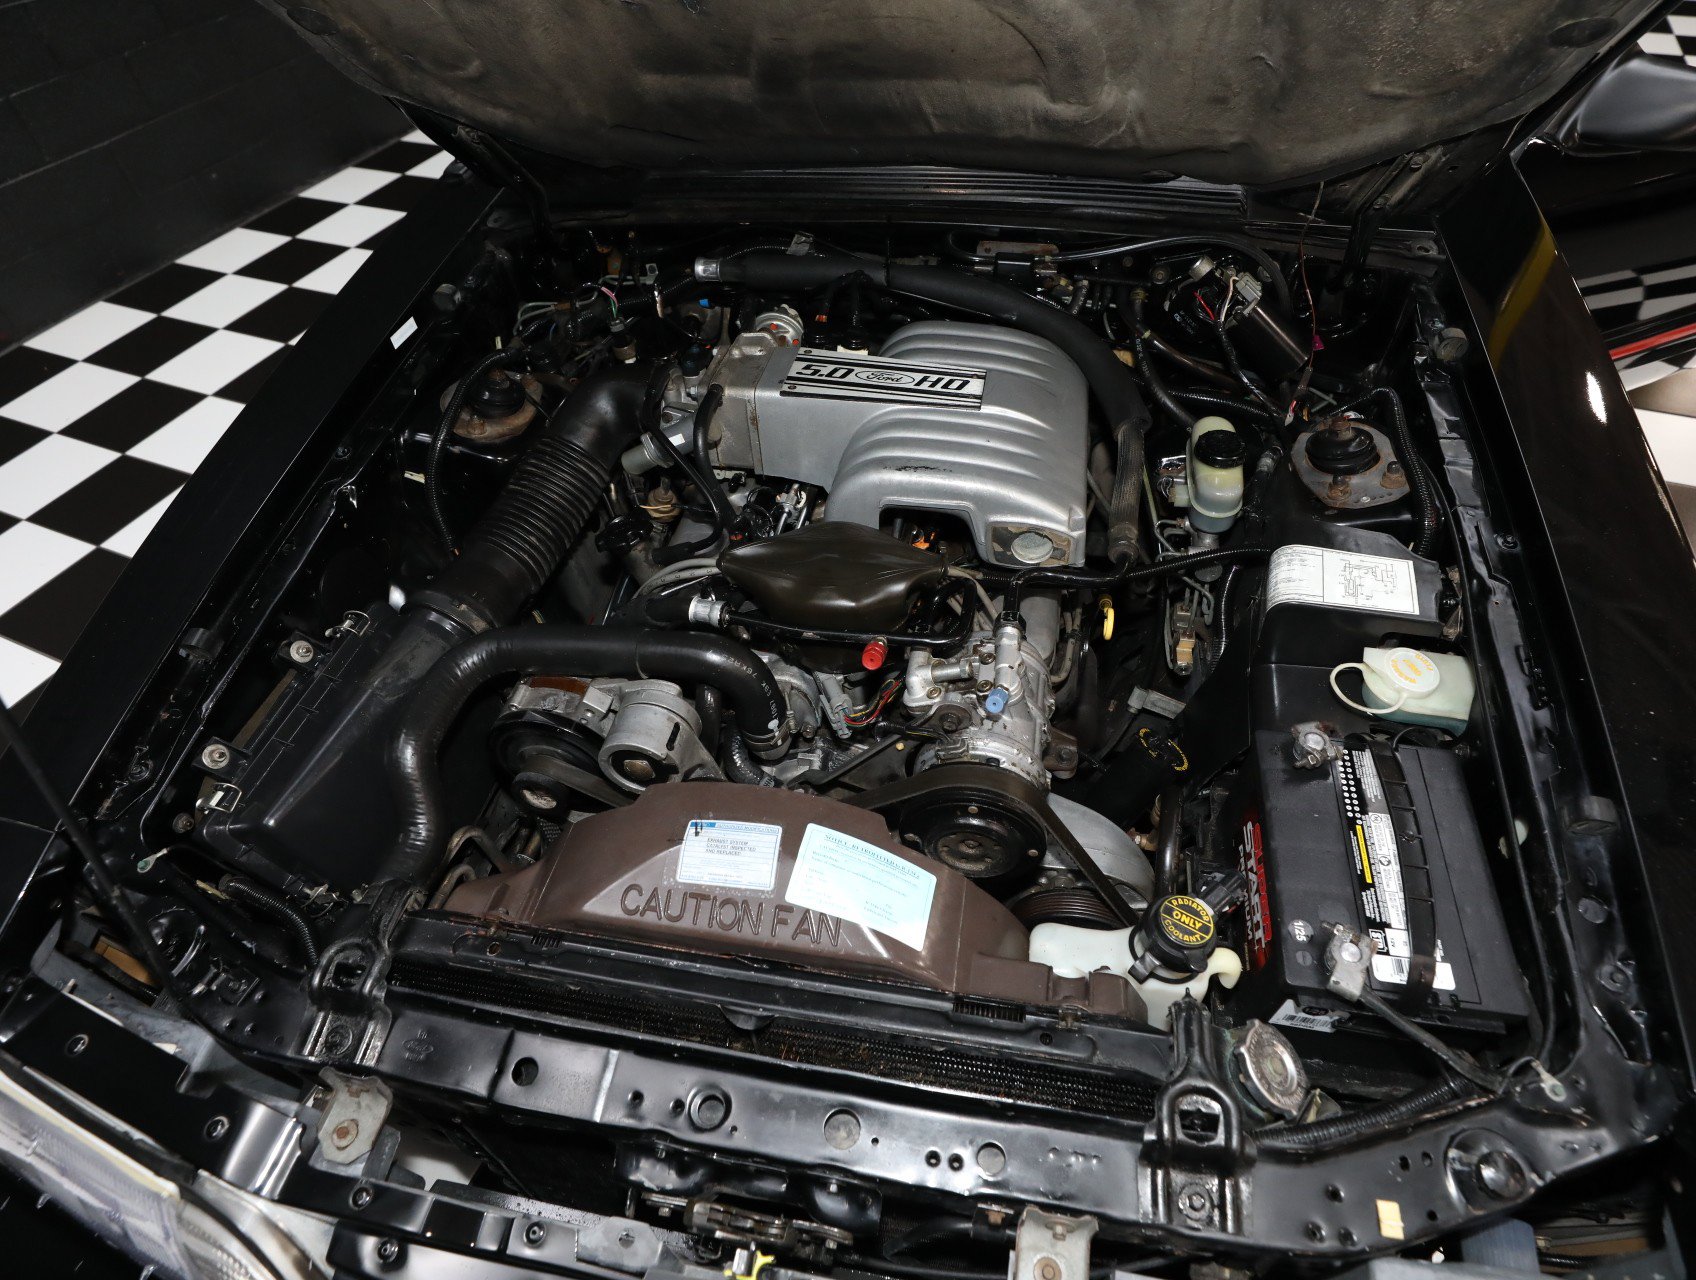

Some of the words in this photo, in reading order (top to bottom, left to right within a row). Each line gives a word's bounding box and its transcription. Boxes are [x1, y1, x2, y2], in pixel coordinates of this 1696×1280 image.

[796, 364, 854, 379] 5.0
[866, 370, 904, 384] Ford
[914, 375, 971, 391] HO
[730, 844, 756, 852] INSPECTED
[1244, 821, 1265, 948] START
[621, 883, 764, 935] CAUTION
[771, 904, 842, 947] FAN
[1171, 898, 1210, 921] RADIATOR
[1173, 910, 1202, 930] ONLY
[1165, 919, 1201, 942] COOLANT
